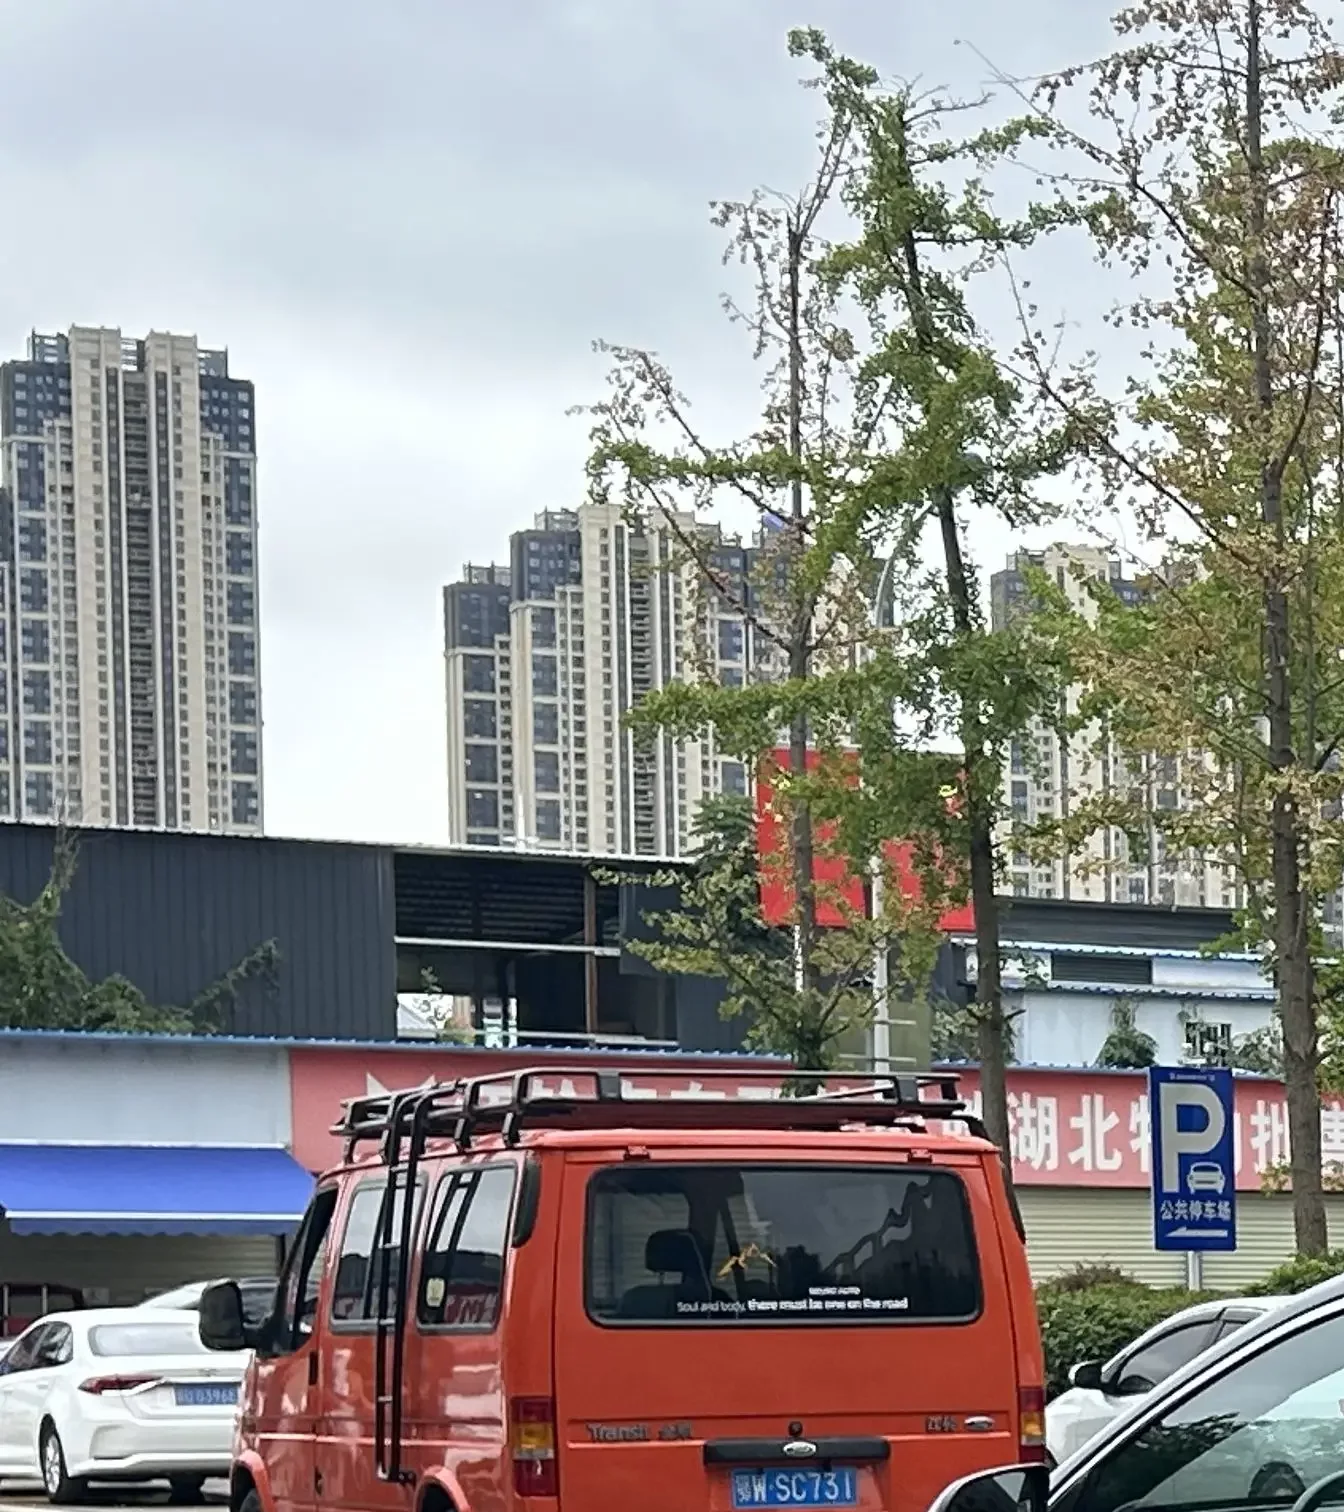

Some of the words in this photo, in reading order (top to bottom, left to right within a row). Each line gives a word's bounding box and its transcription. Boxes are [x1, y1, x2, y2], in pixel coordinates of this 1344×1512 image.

[1160, 1083, 1225, 1193] P
[1160, 1200, 1231, 1221] 公共停车场
